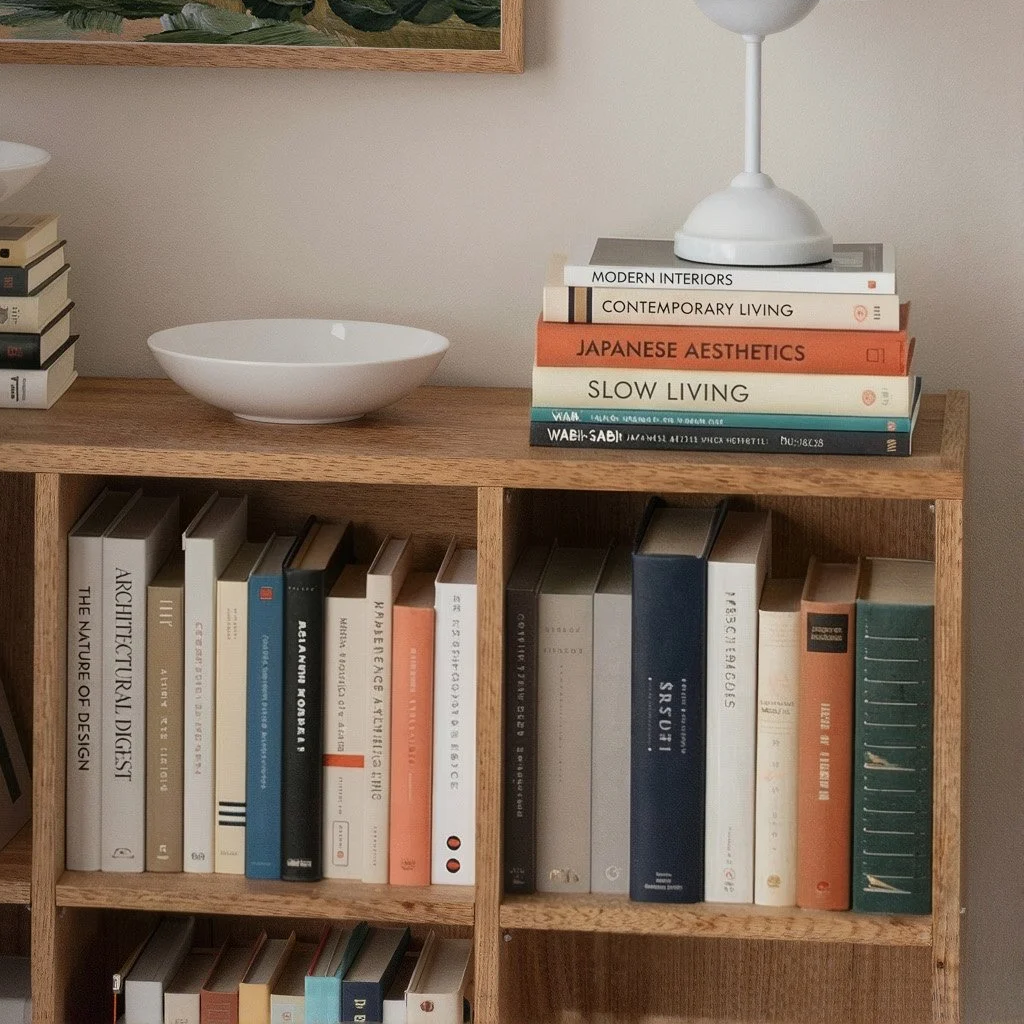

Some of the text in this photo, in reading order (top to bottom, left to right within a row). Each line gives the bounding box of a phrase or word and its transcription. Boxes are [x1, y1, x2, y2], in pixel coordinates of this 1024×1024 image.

[592, 271, 733, 286] MODERN INTERIORS
[602, 300, 794, 317] CONTEMPORARY LIVING
[577, 339, 806, 362] JAPANESE AESTHETICS
[588, 380, 749, 403] SLOW LIVING
[78, 586, 91, 771] THE NATURE OF DESIGN
[114, 567, 133, 781] ARCHITECTURAL DIGEST
